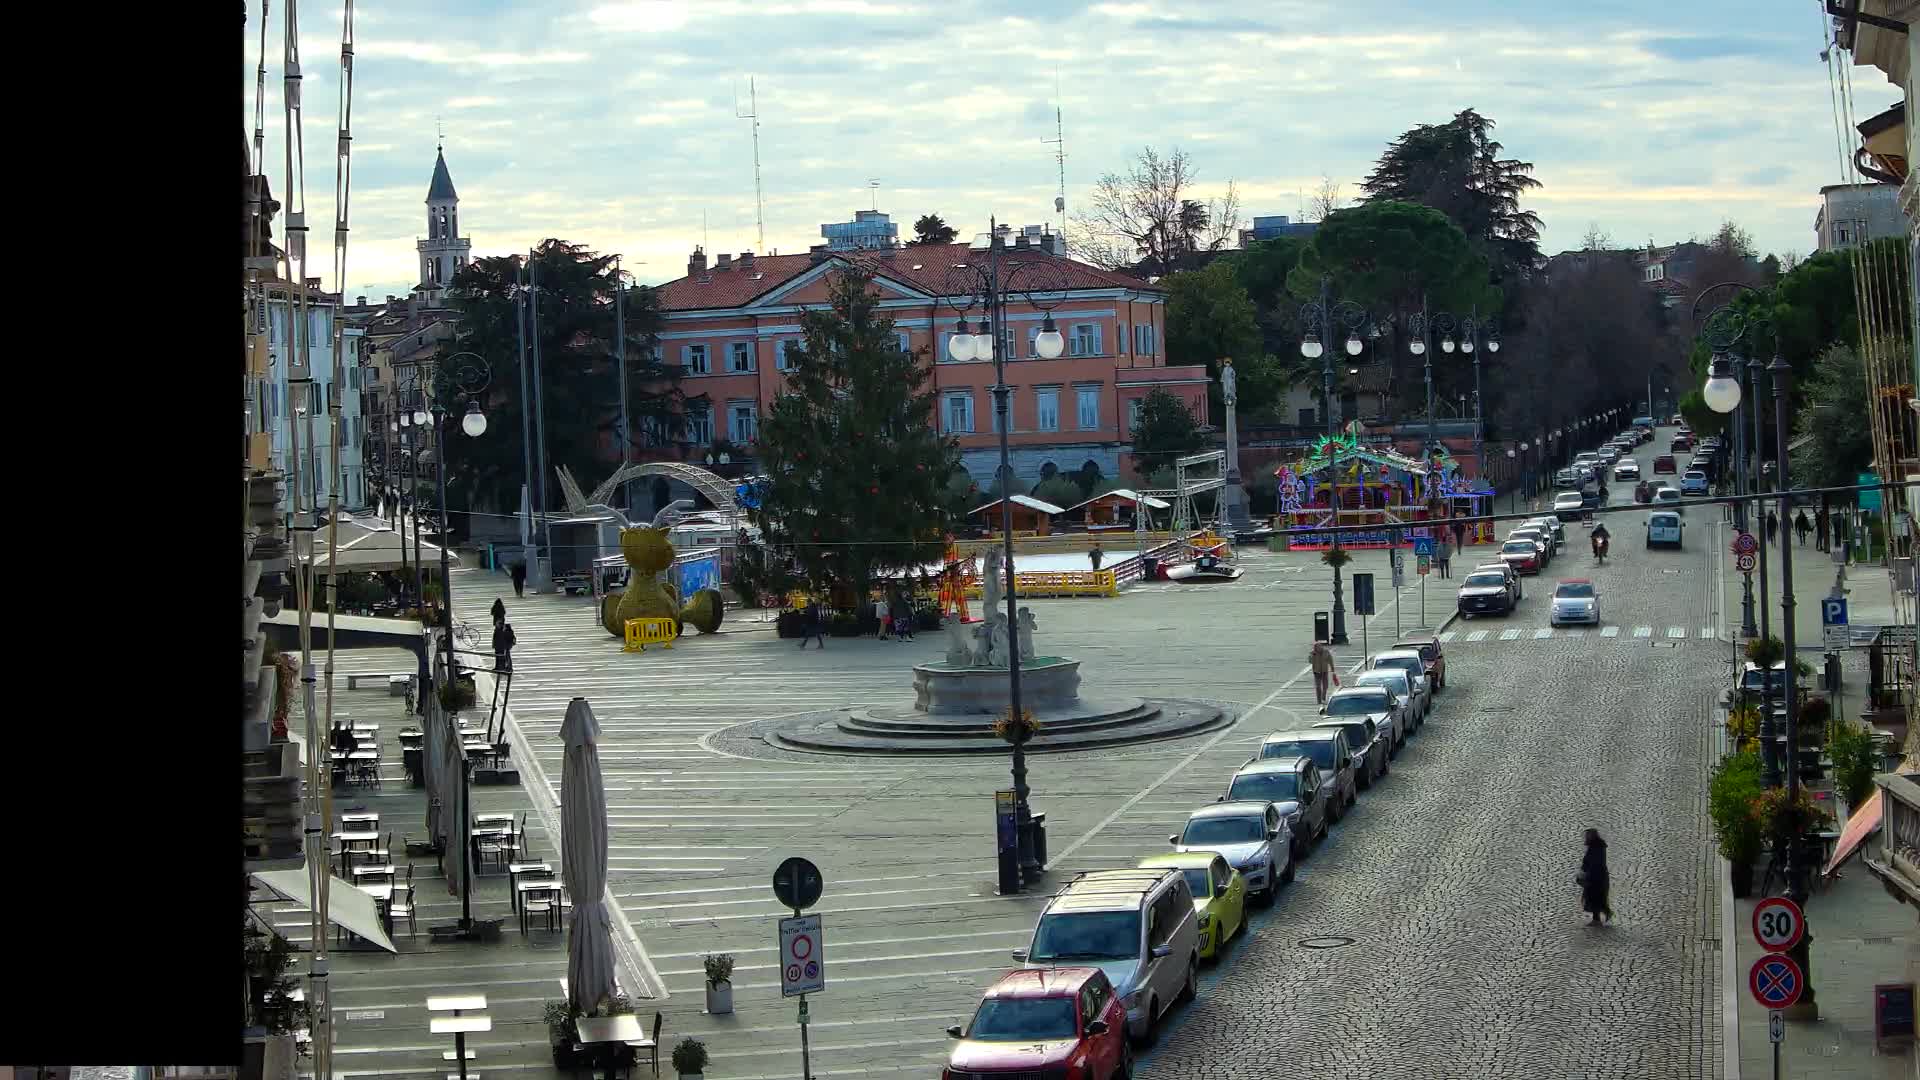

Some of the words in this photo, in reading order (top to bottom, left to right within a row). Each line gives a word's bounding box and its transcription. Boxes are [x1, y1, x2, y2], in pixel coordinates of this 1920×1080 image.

[1743, 557, 1753, 567] 20
[1828, 602, 1841, 622] P
[1762, 912, 1791, 938] 30
